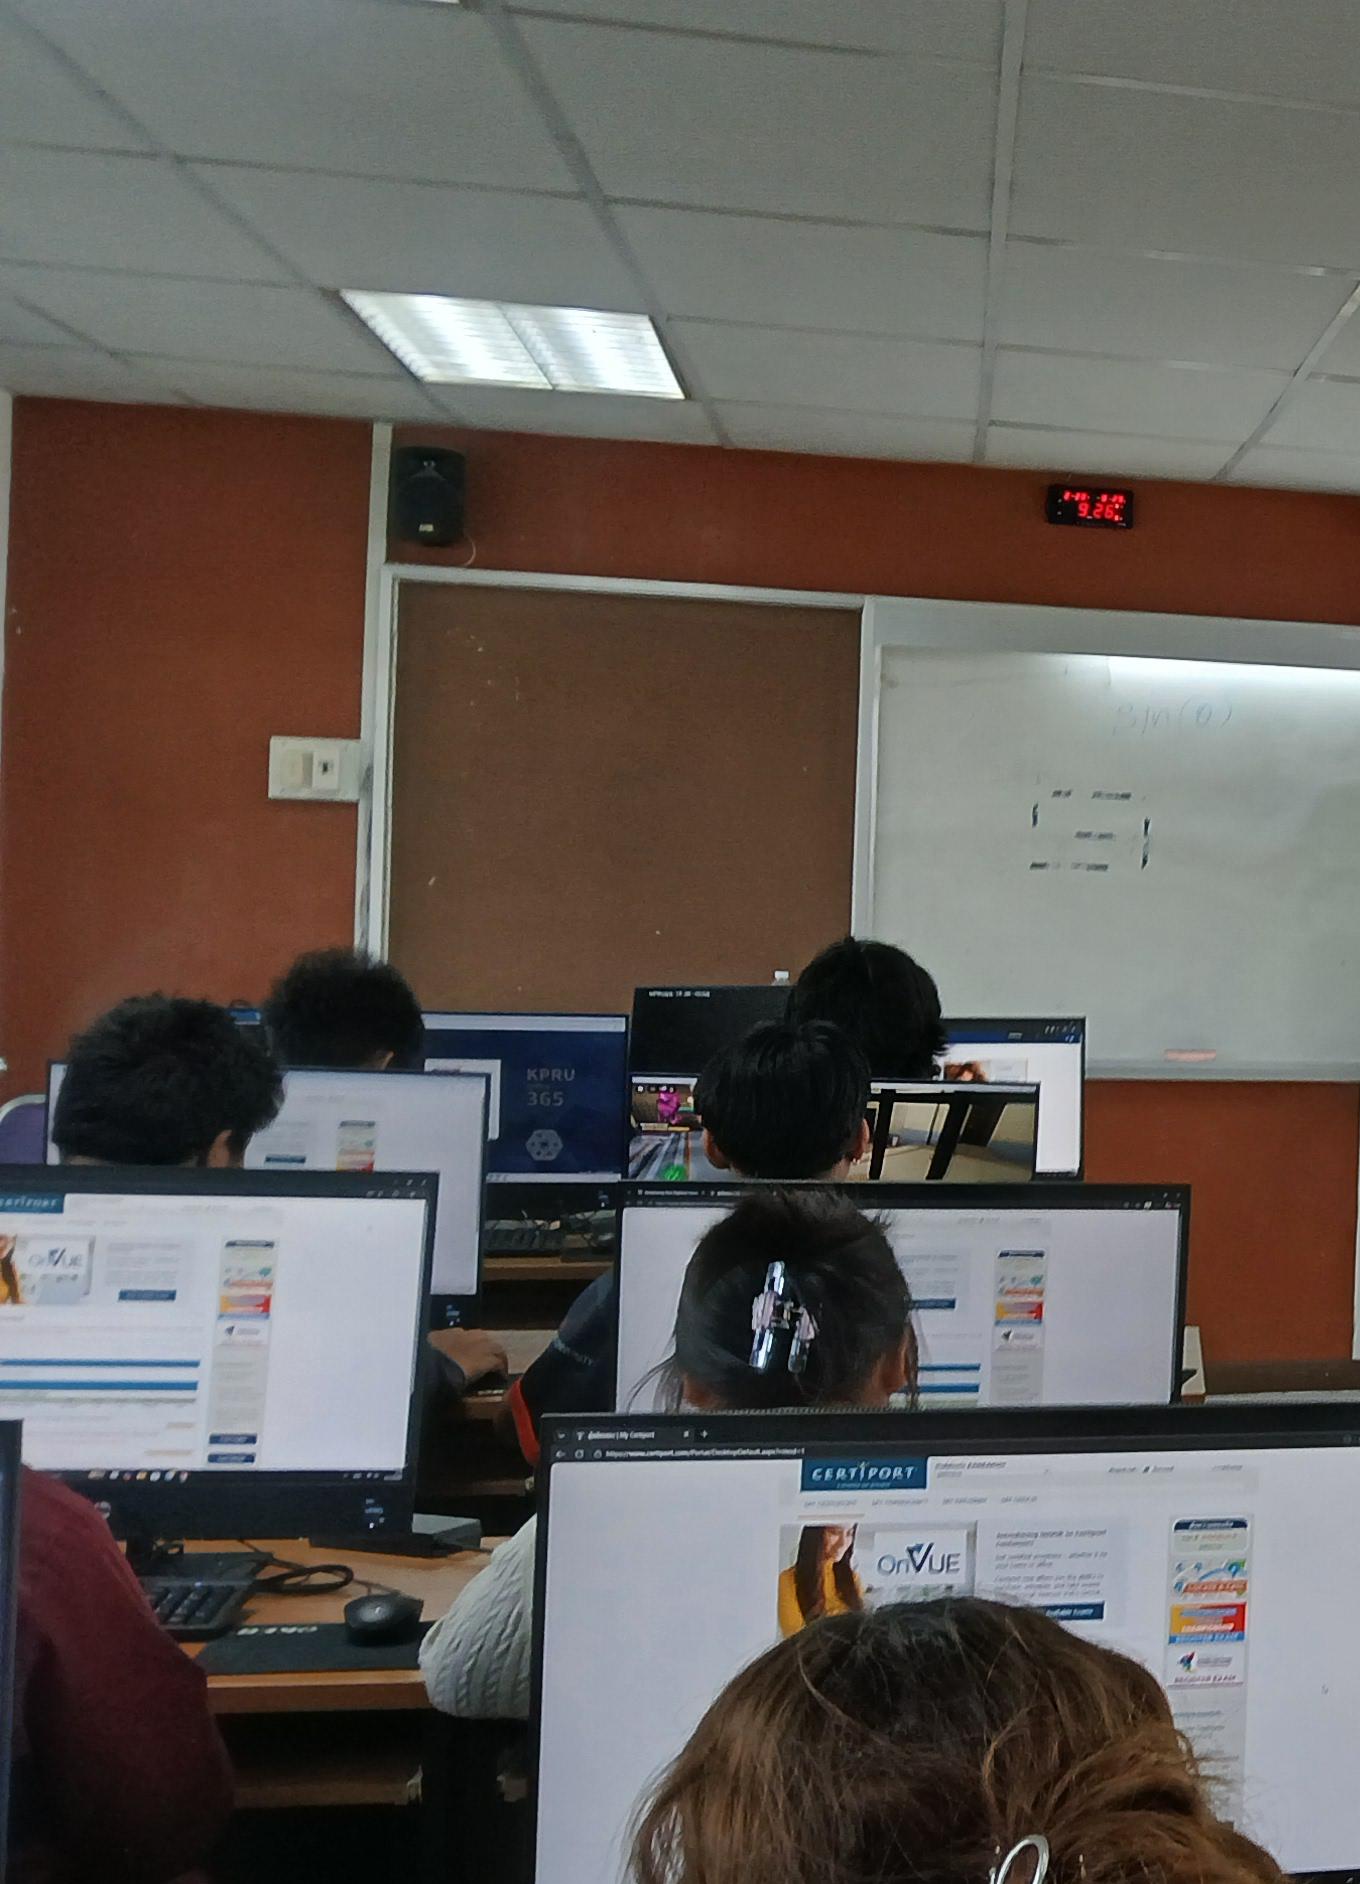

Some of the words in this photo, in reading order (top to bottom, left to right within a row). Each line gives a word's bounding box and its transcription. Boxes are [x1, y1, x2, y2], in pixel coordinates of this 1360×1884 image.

[527, 1068, 576, 1082] KPRU
[527, 1091, 565, 1107] 365
[811, 1461, 915, 1483] CERTIPORT
[876, 1542, 961, 1576] OnVUE
